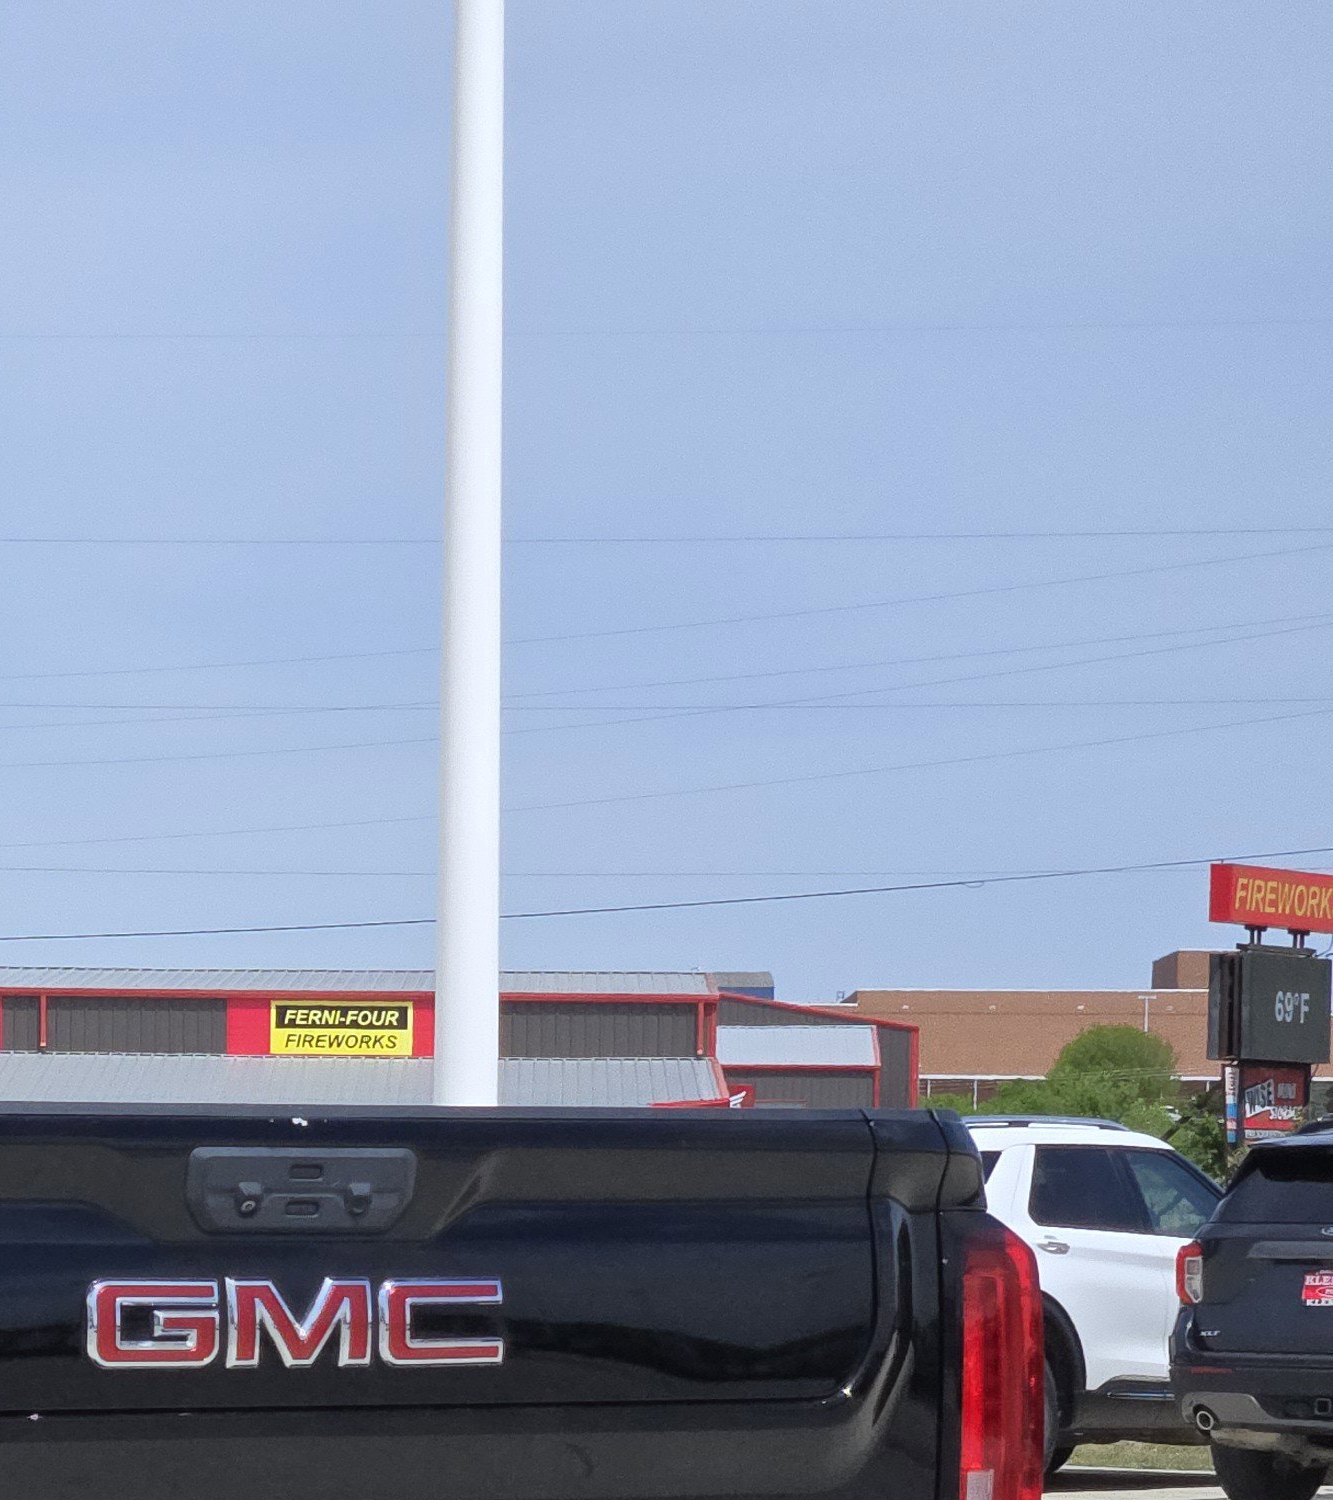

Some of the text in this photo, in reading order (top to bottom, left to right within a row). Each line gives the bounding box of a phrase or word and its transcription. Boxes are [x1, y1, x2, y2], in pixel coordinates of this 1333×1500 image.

[1235, 877, 1333, 919] FIREWORK
[284, 1009, 399, 1026] FERNI-FOUR
[285, 1033, 397, 1049] FIREWORKS
[86, 1276, 504, 1369] GMC
